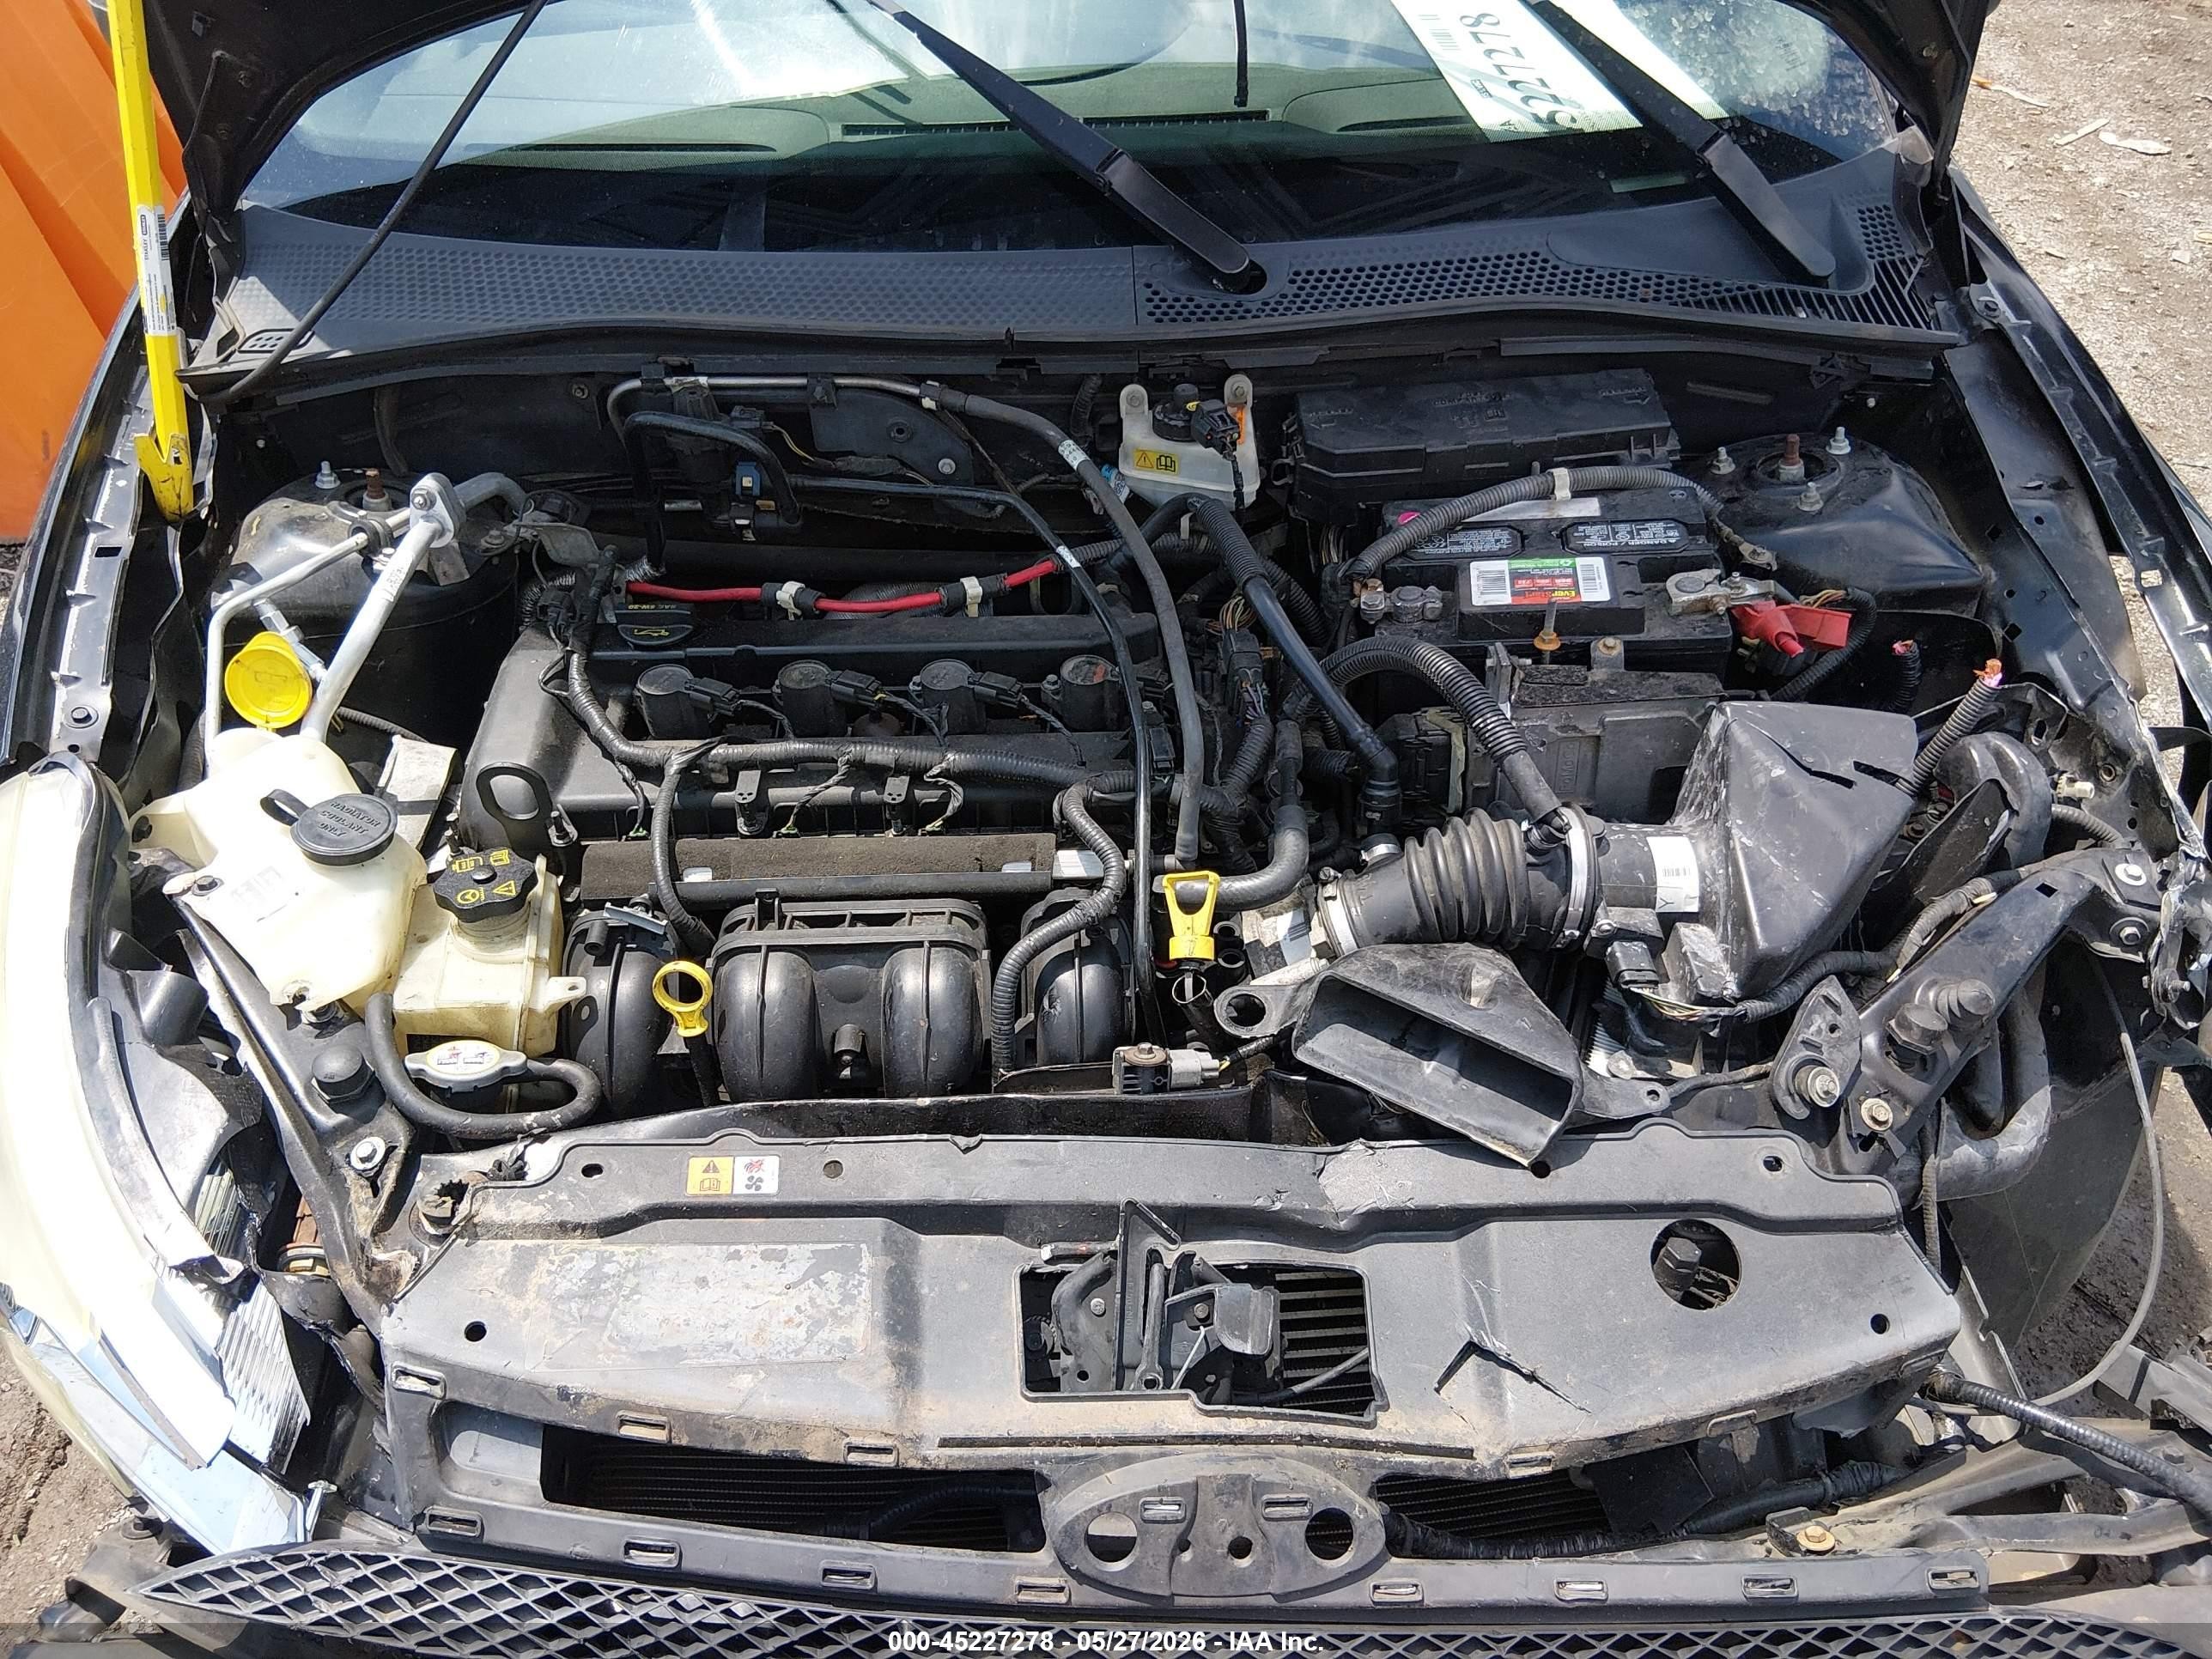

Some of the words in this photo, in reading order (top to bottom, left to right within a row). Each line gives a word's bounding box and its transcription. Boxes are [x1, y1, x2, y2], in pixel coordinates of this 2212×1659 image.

[1460, 13, 1583, 131] 5227278
[320, 810, 368, 834] COOLANT
[331, 801, 381, 827] RADIATOR
[319, 823, 346, 837] ONLY
